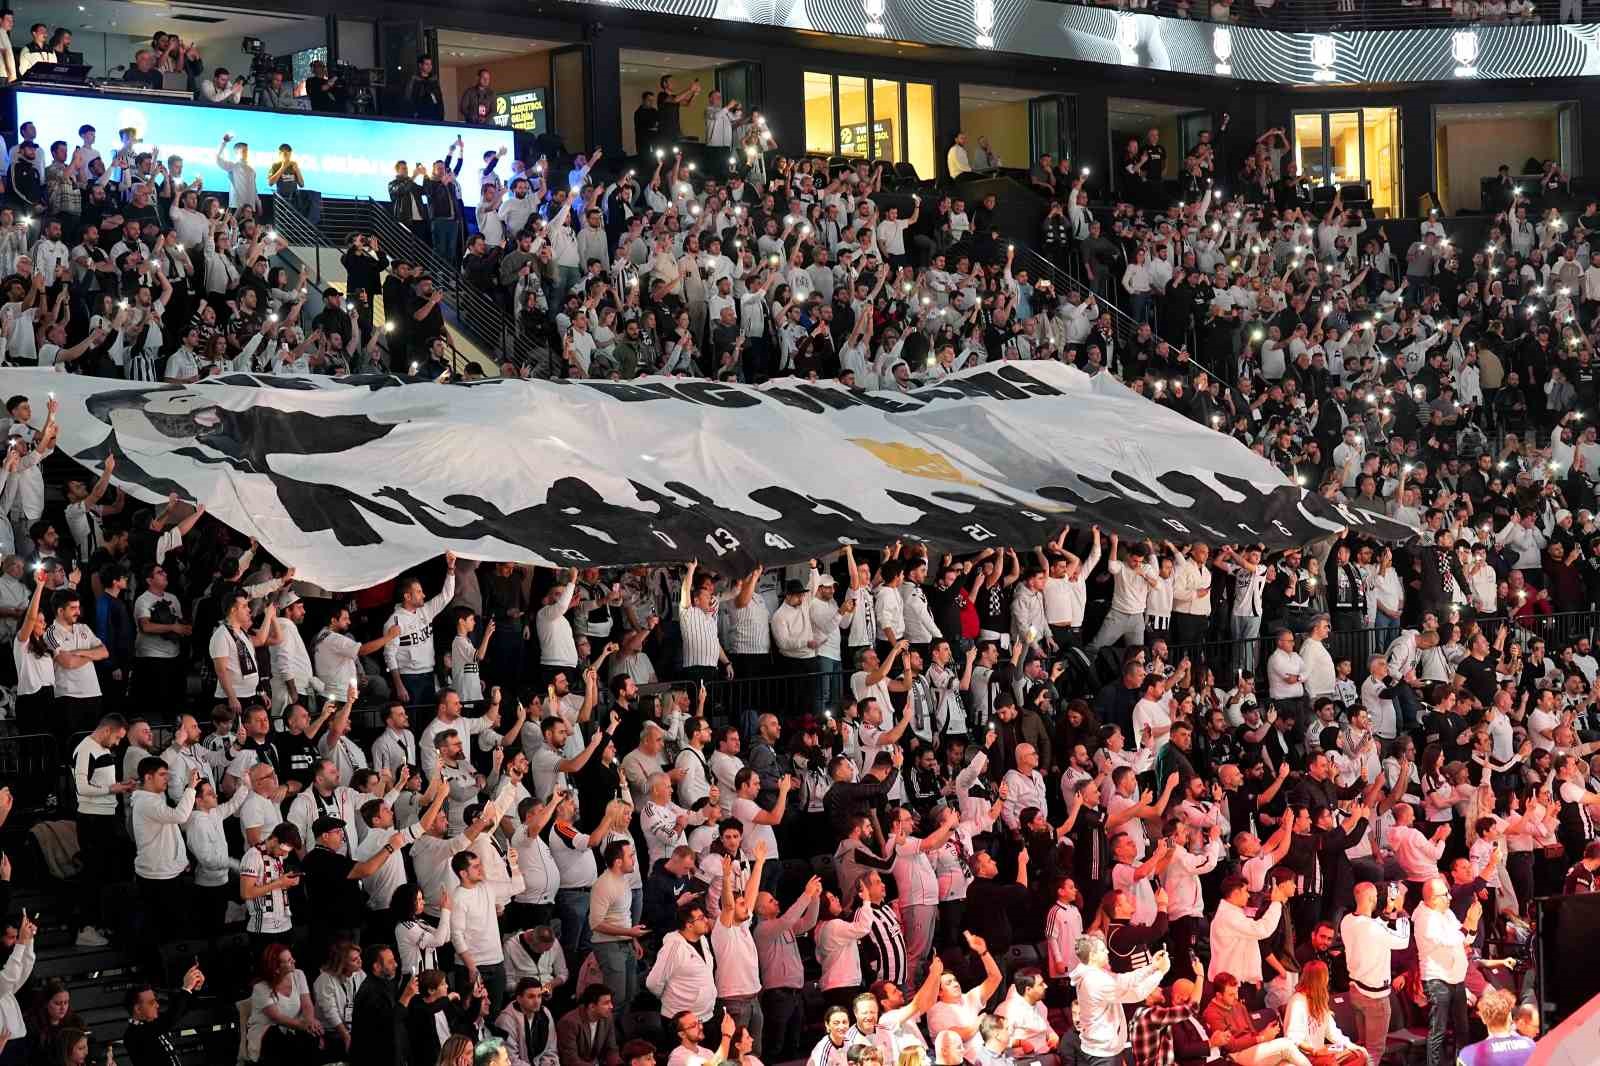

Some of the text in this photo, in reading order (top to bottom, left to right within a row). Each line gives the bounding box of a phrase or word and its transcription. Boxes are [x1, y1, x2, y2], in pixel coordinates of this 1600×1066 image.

[705, 527, 740, 556] 13
[961, 523, 997, 542] 21
[412, 623, 432, 646] BJK
